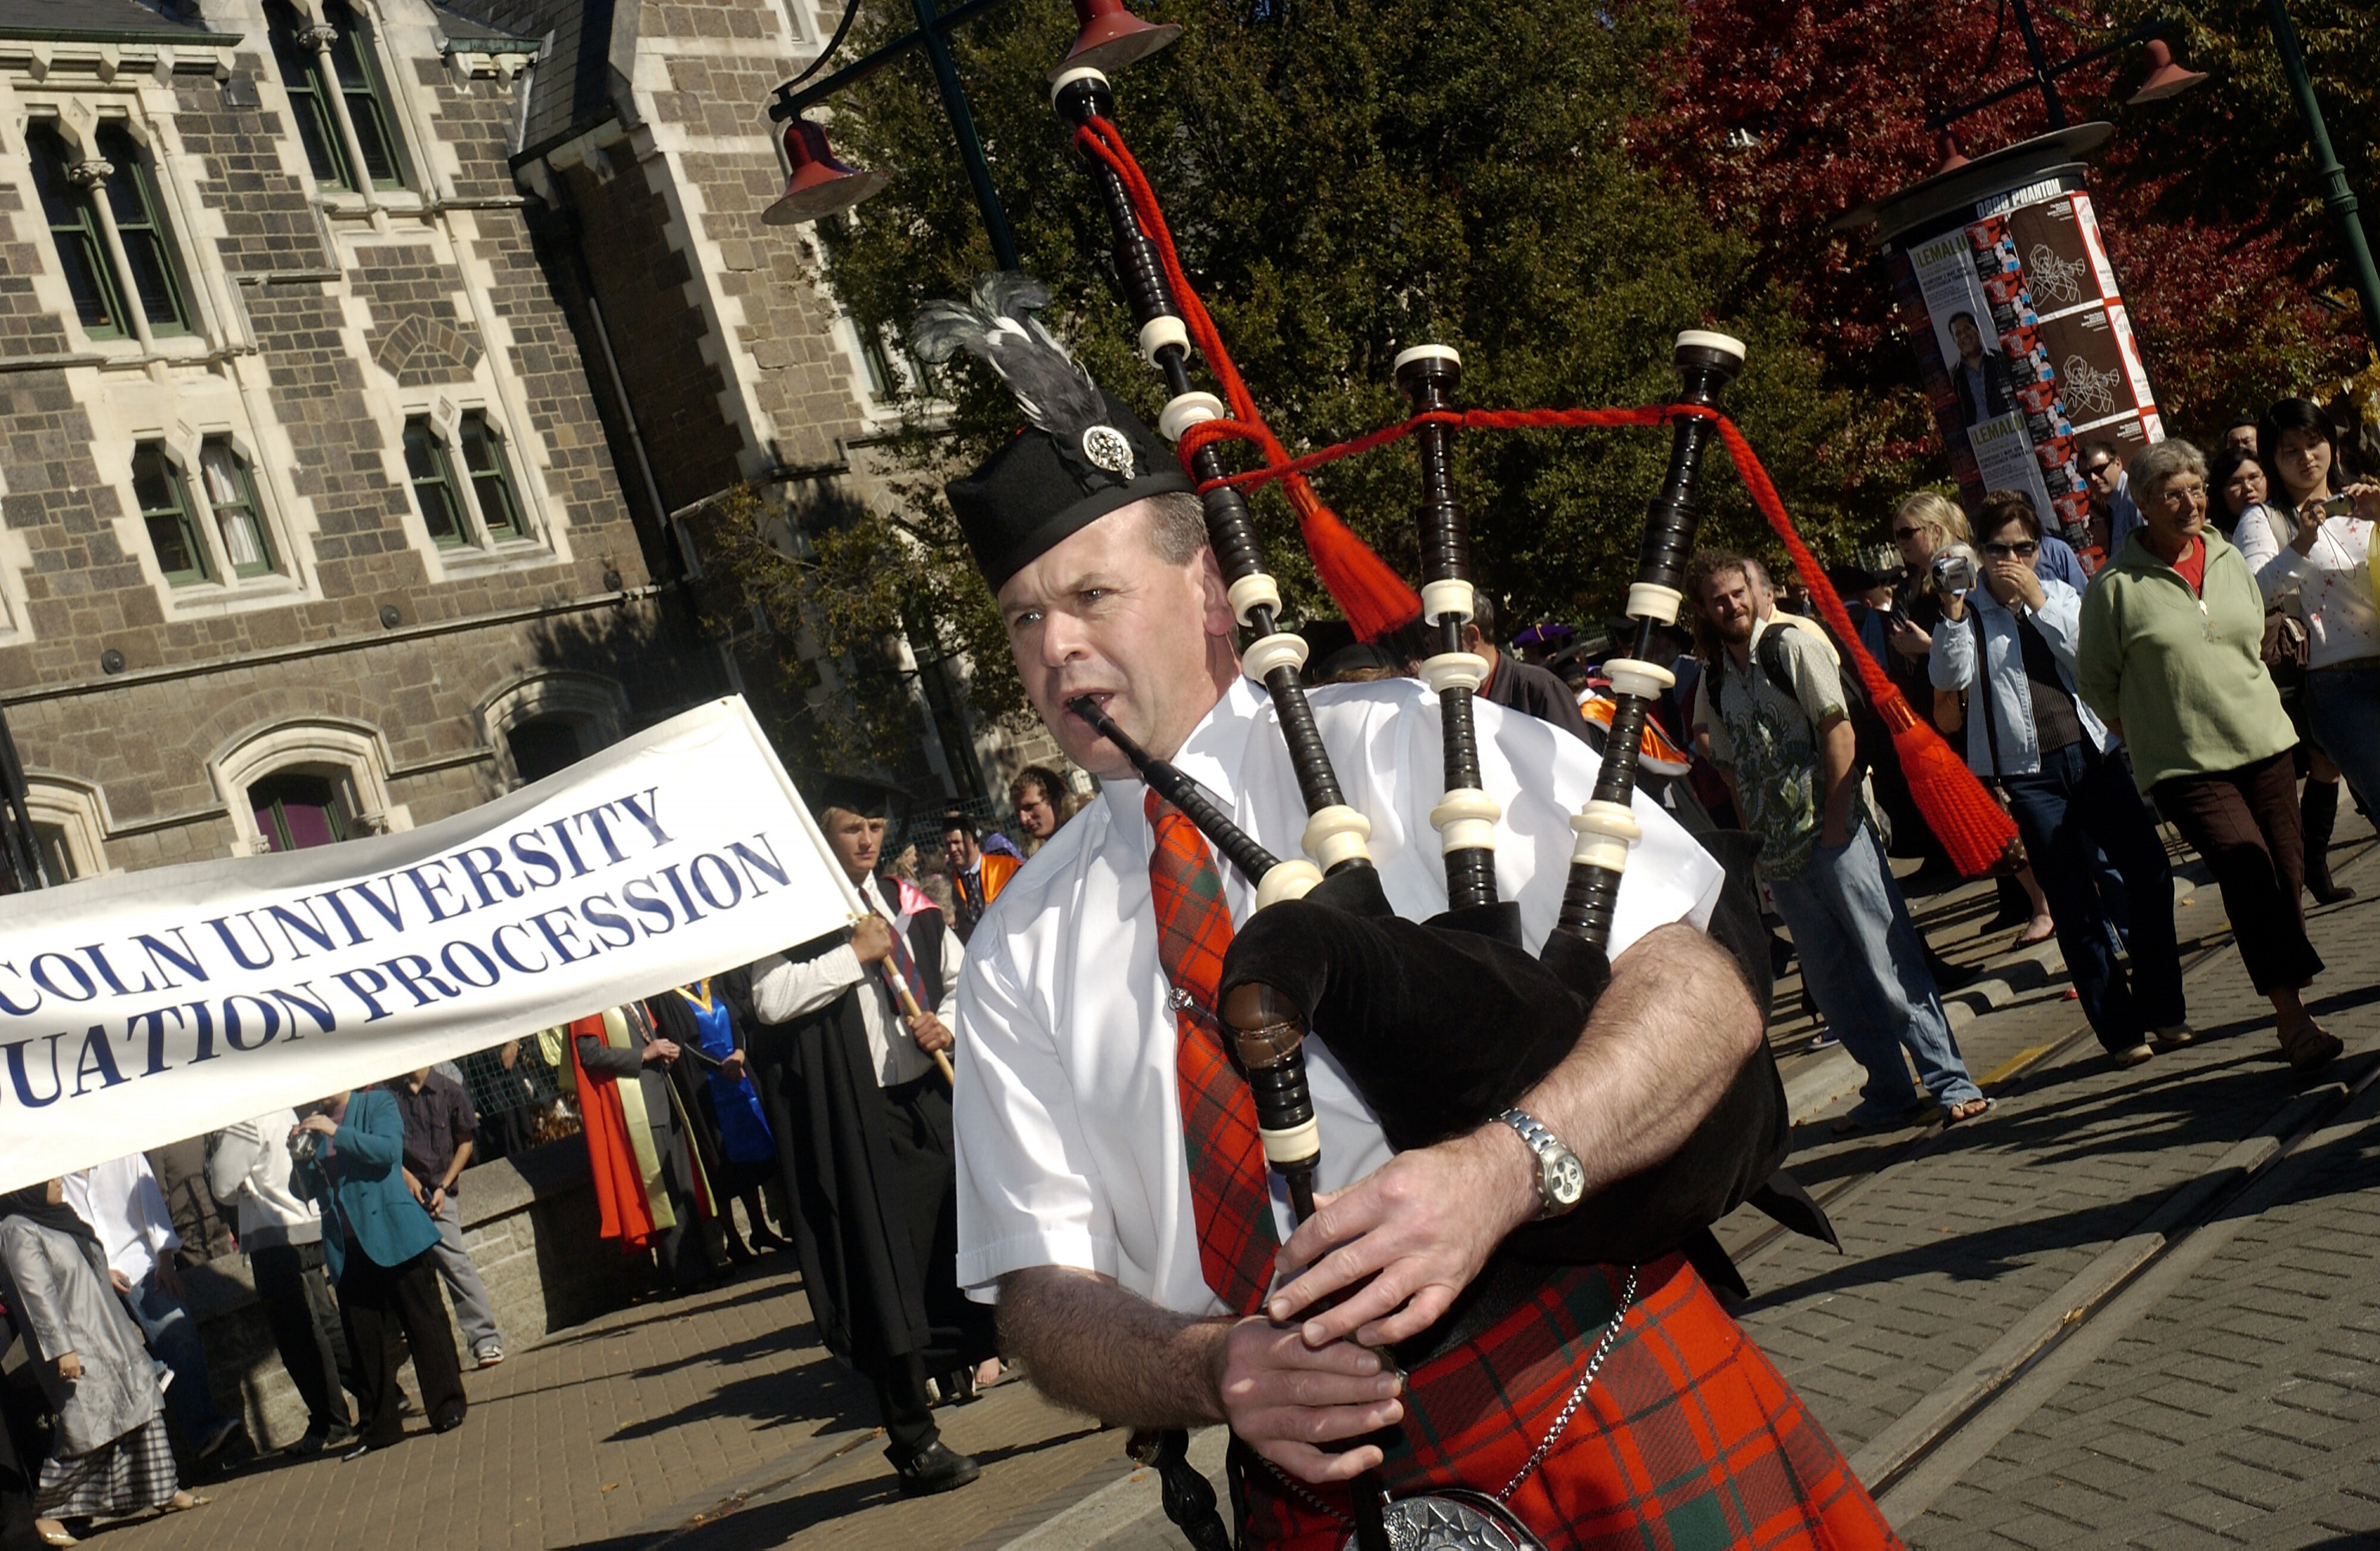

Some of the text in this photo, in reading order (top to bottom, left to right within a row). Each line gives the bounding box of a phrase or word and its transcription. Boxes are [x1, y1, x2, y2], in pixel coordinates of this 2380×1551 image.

[1976, 178, 2062, 218] 0800 PHANTOM
[0, 832, 792, 1108] UATION PROCESSION
[203, 787, 675, 970] UNIVERSITY
